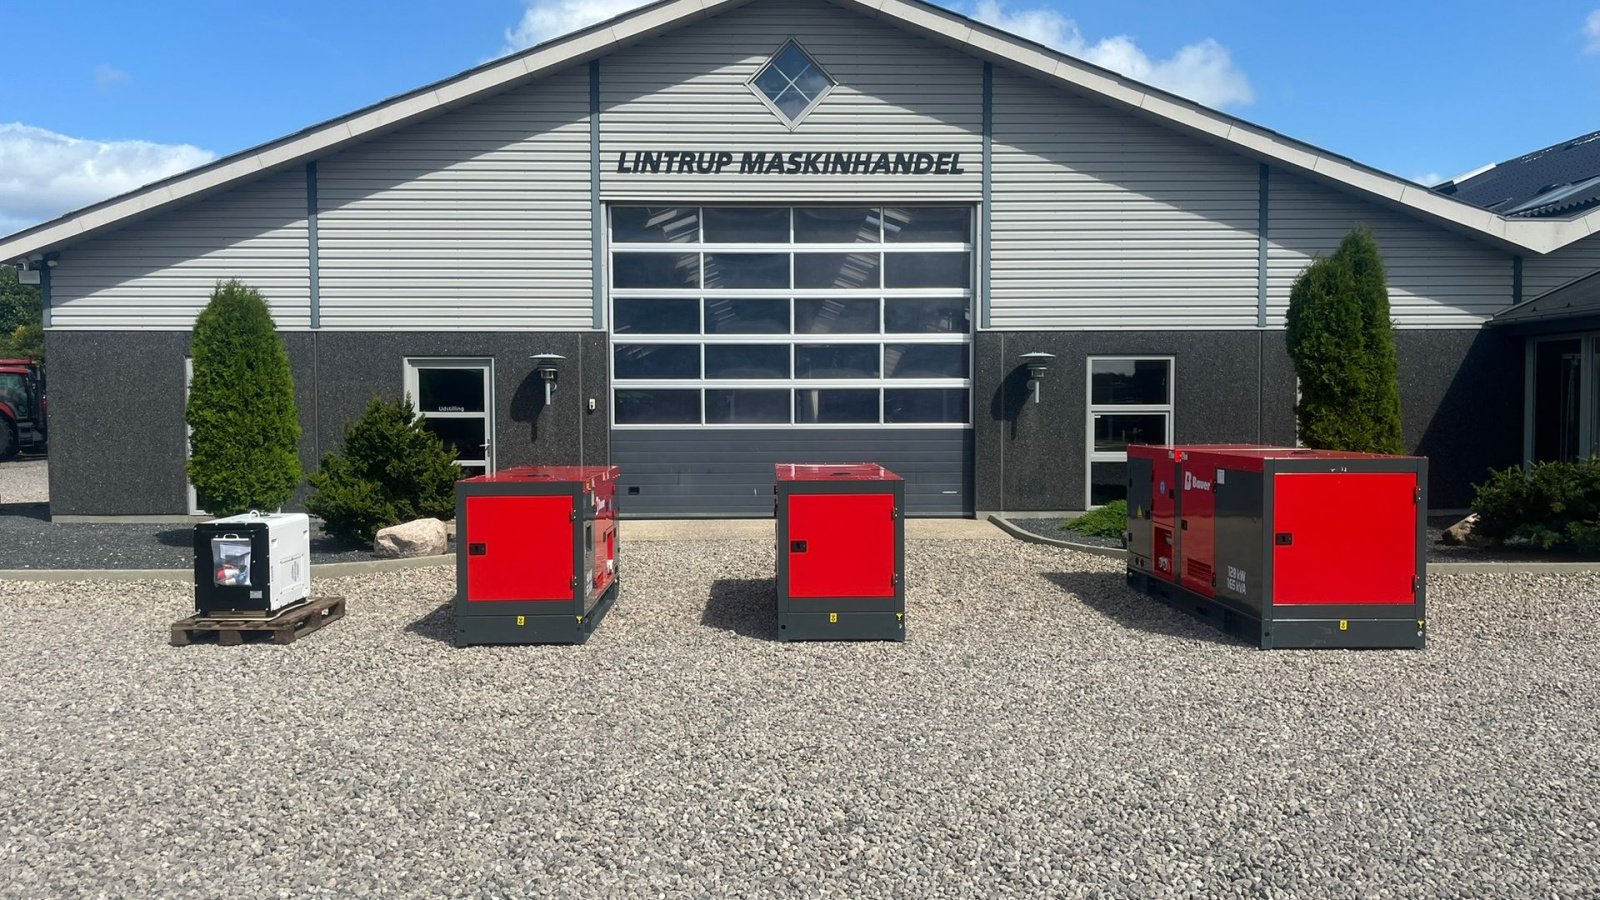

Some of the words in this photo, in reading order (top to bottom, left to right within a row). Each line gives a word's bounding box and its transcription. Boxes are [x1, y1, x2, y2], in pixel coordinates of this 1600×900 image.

[616, 151, 733, 174] LINTRUP
[738, 151, 965, 175] MASKINHANDEL
[1192, 476, 1211, 491] Bauer
